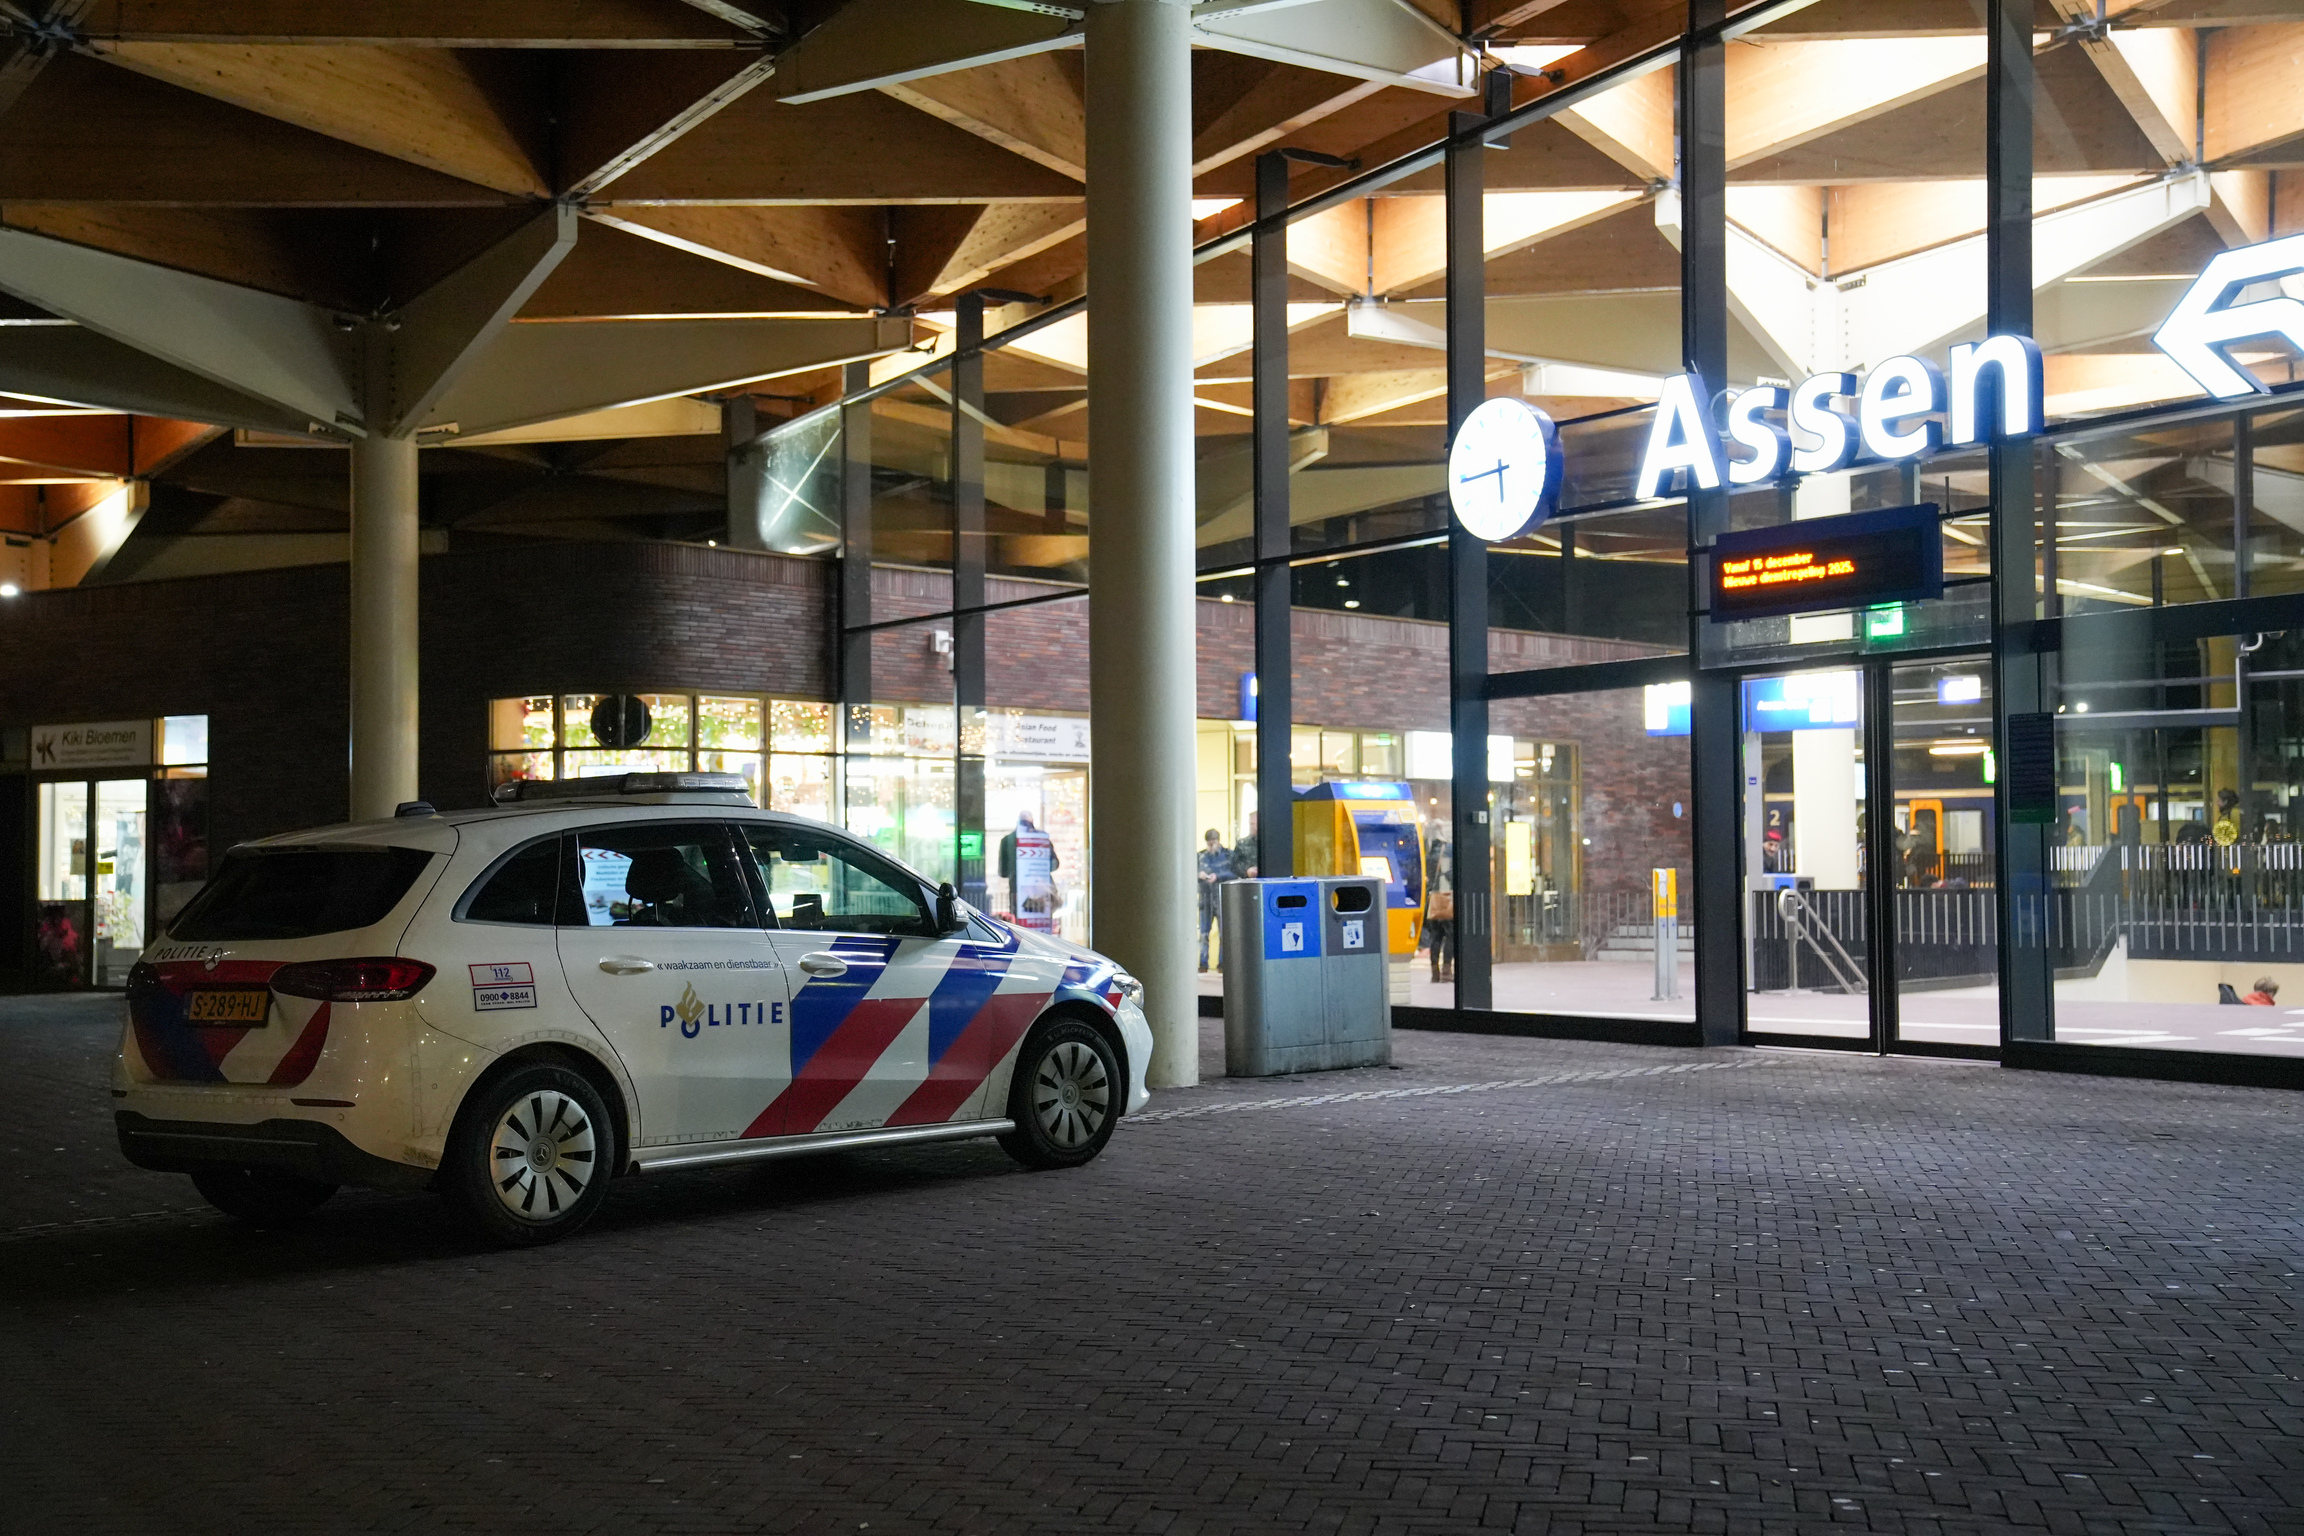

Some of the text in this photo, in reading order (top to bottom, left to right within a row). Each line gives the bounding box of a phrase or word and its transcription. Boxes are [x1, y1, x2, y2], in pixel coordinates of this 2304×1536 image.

[1636, 334, 2044, 500] Assen
[1723, 559, 1750, 574] Vanaf
[1765, 553, 1813, 569] december
[1723, 560, 1855, 588] Nieuwe dienstregeling 2025.
[1038, 723, 1058, 733] Food
[85, 728, 137, 746] Bloemen
[1769, 810, 1780, 826] 2
[154, 946, 208, 960] POLITIE
[665, 960, 712, 970] waakzaam
[726, 959, 771, 970] dienstbaar
[480, 991, 529, 1002] 0900 8844
[661, 1001, 783, 1038] POLITIE
